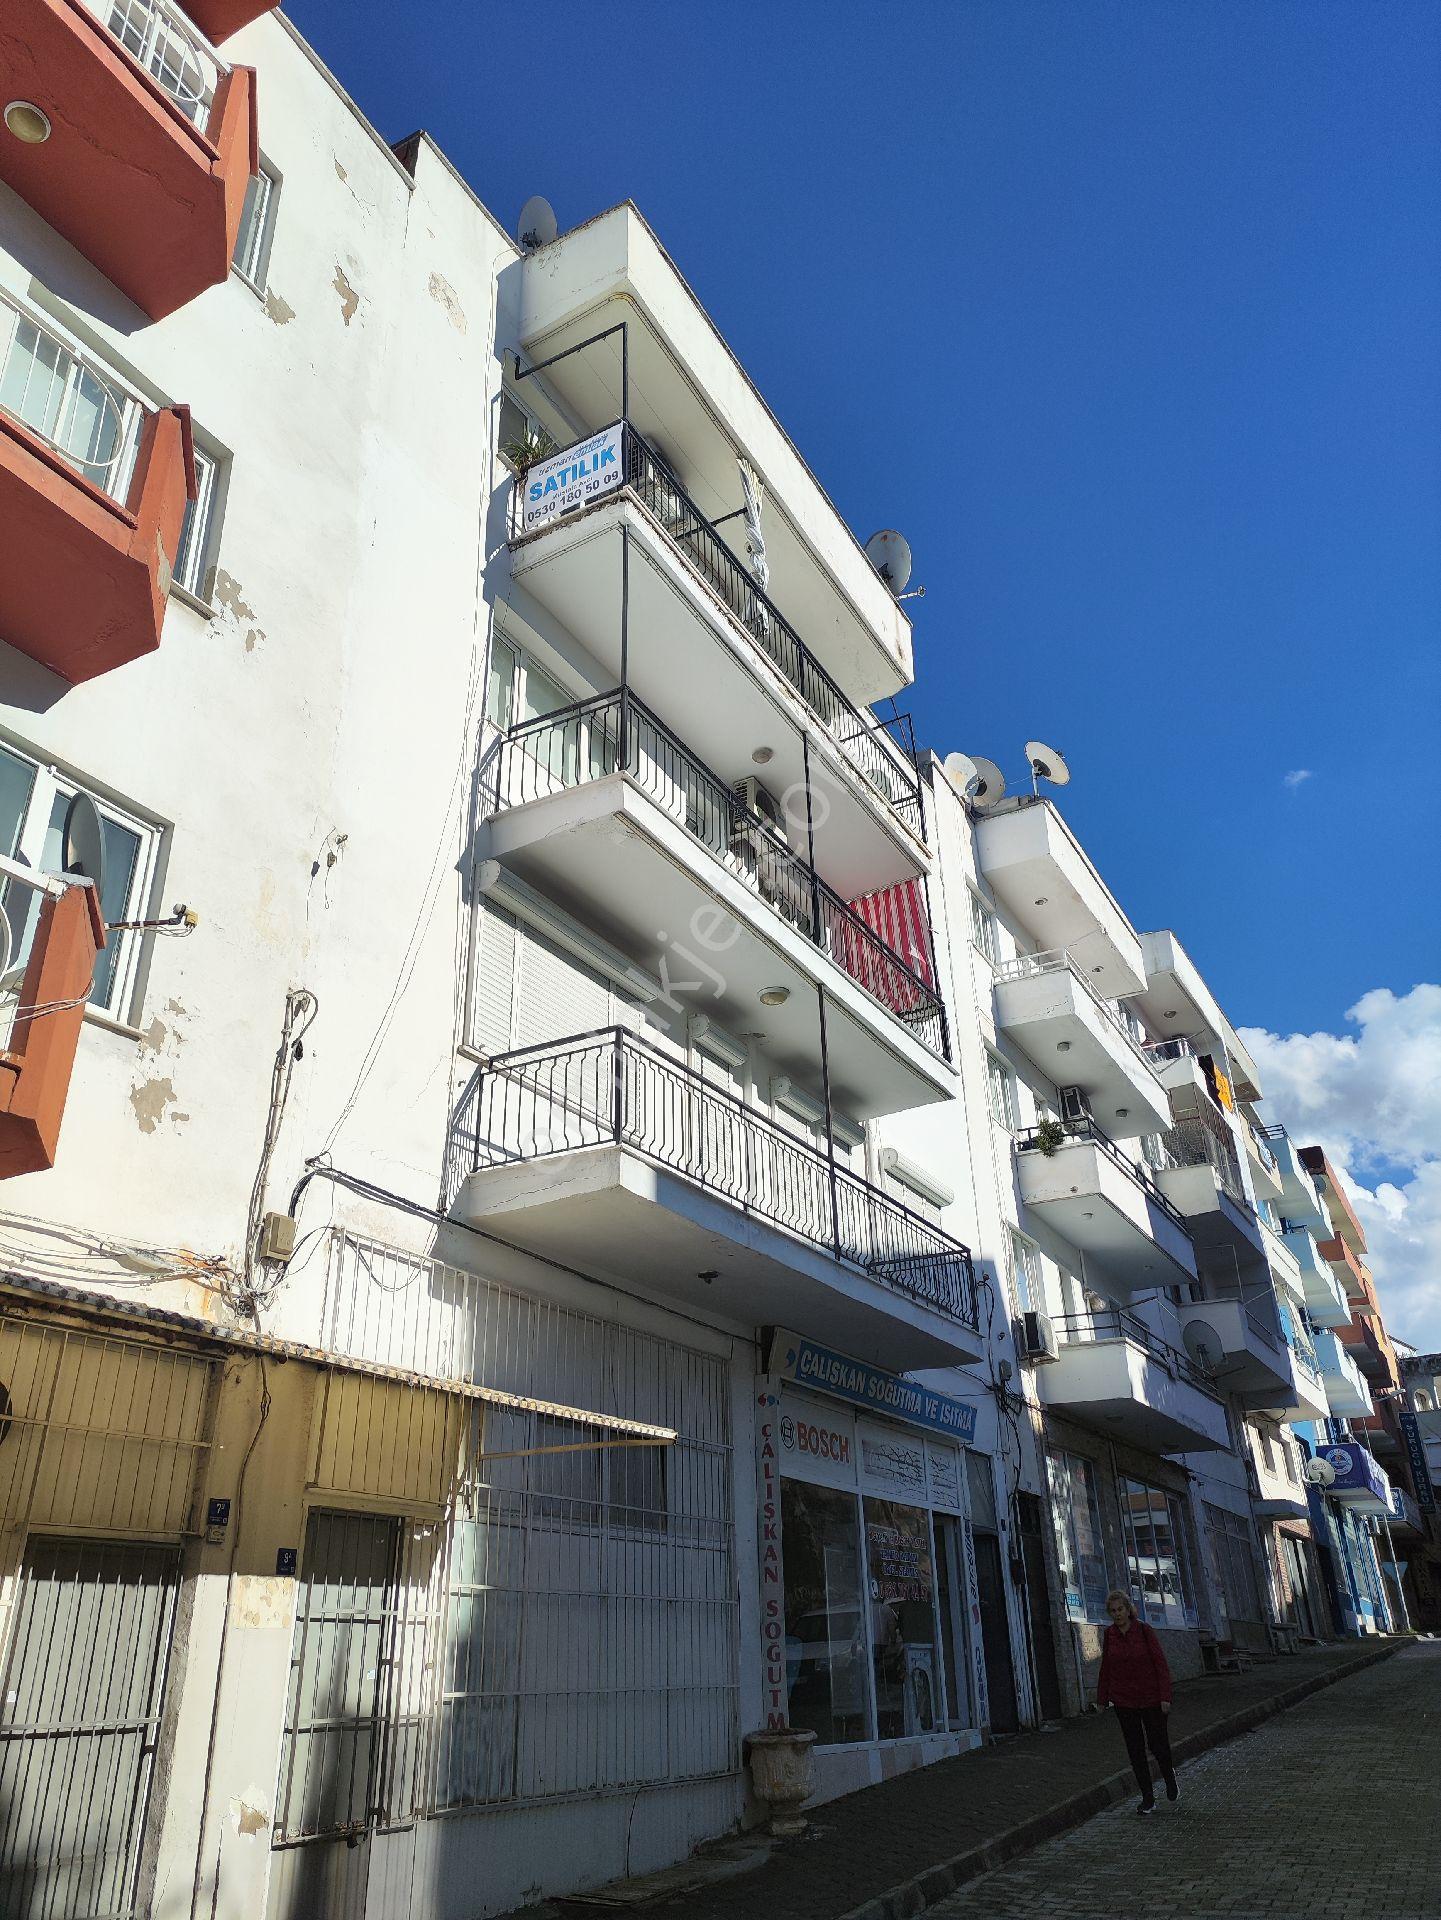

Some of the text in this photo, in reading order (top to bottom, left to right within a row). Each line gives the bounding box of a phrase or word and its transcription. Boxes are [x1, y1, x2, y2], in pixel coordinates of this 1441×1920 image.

[527, 470, 619, 522] 0530 180 50 09
[529, 443, 616, 502] SATILIK
[800, 1349, 867, 1393] ÇALIŞKAN
[868, 1374, 921, 1413] SOĞUTMA
[925, 1397, 937, 1419] VE
[797, 1421, 850, 1464] BOSCH
